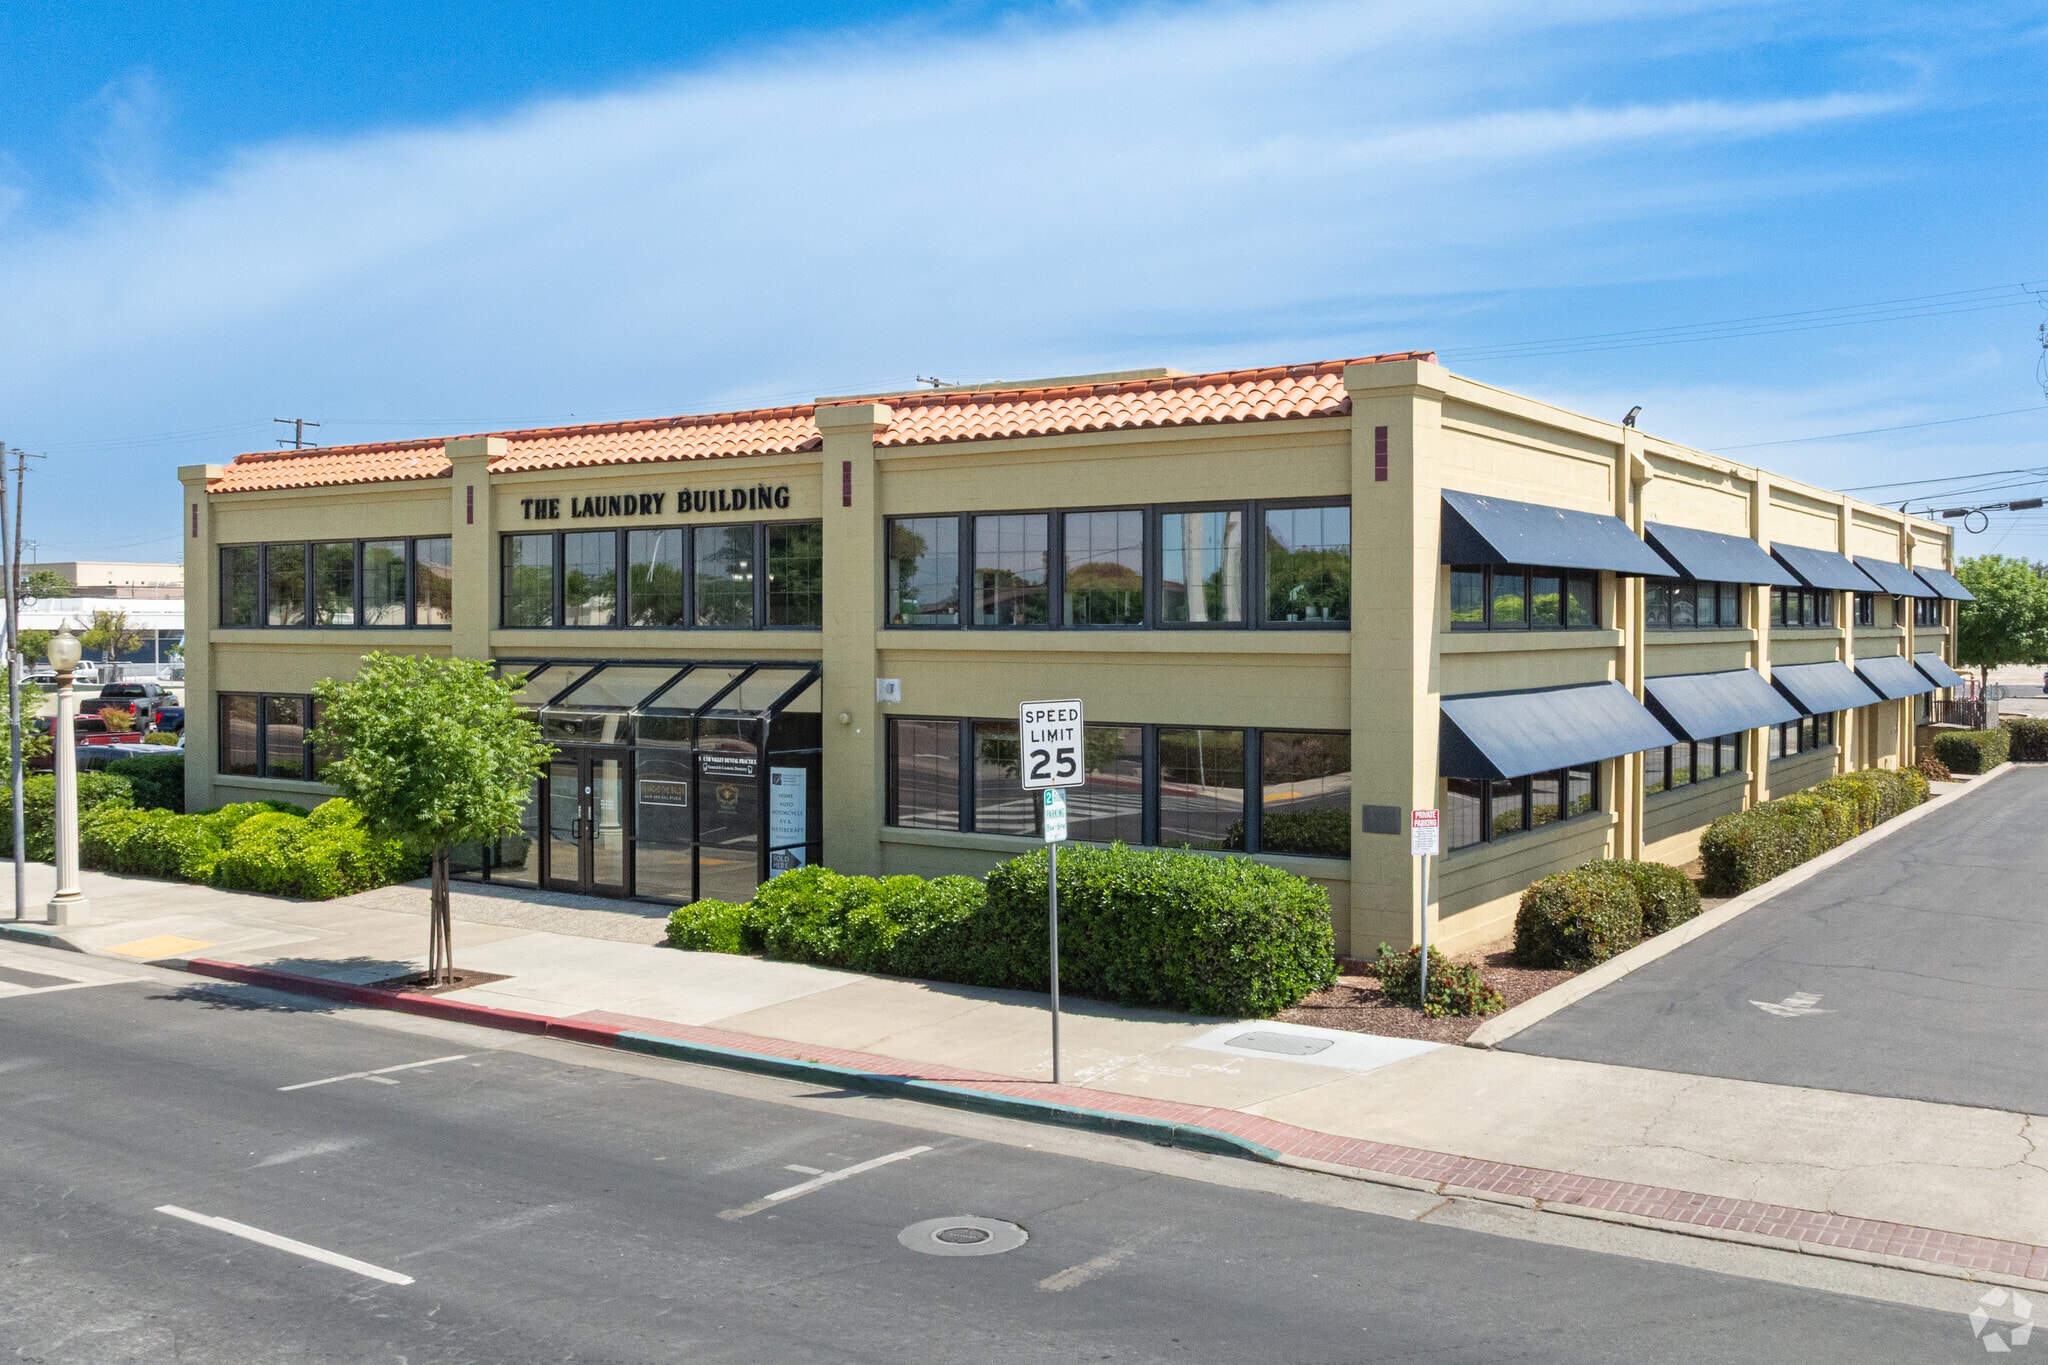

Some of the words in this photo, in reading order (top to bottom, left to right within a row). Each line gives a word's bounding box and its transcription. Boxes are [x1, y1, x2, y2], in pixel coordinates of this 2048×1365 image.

[521, 497, 560, 519] THE
[571, 493, 666, 518] LAUNDRY
[677, 486, 790, 513] BUILDING
[1025, 709, 1078, 723] SPEED
[1031, 728, 1074, 742] LIMIT
[1030, 747, 1077, 779] 25
[1046, 791, 1052, 804] 2
[1046, 808, 1065, 818] PARKING
[1415, 811, 1436, 819] PRIVATE
[1414, 819, 1437, 827] PARKING
